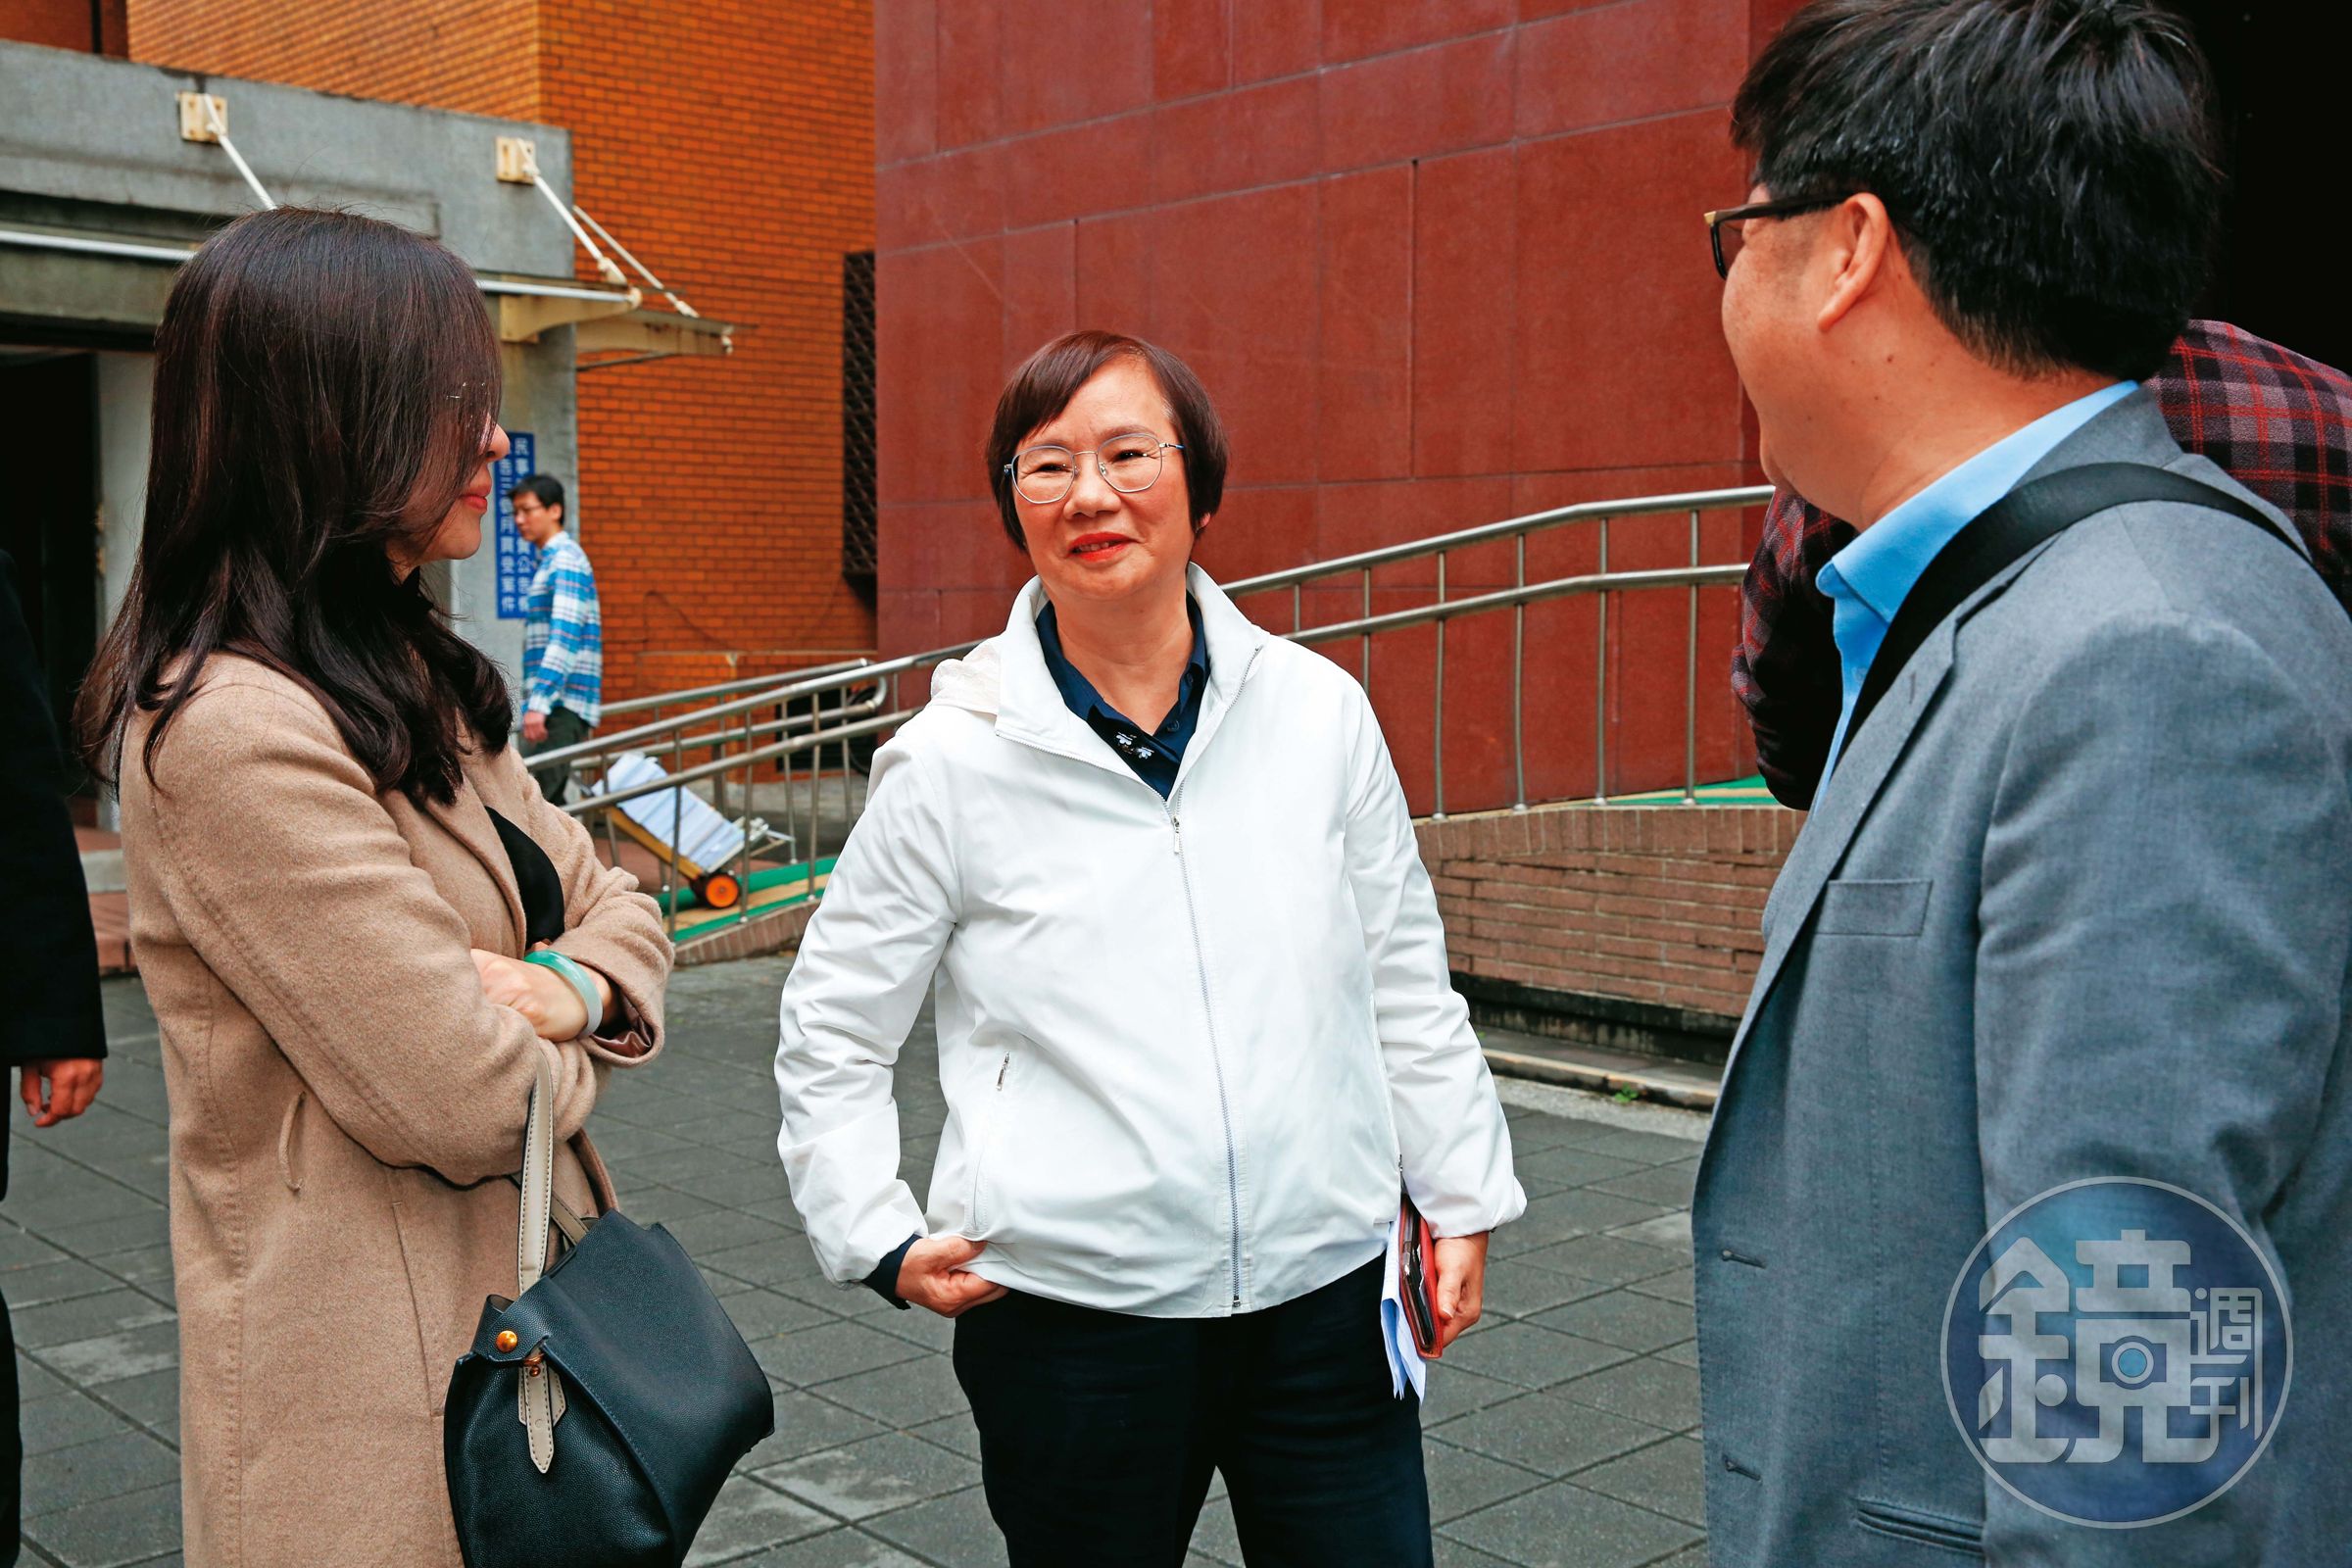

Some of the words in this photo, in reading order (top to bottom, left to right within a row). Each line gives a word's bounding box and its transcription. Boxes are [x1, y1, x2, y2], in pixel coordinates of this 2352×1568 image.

[498, 450, 515, 612] 告三個月買受案件
